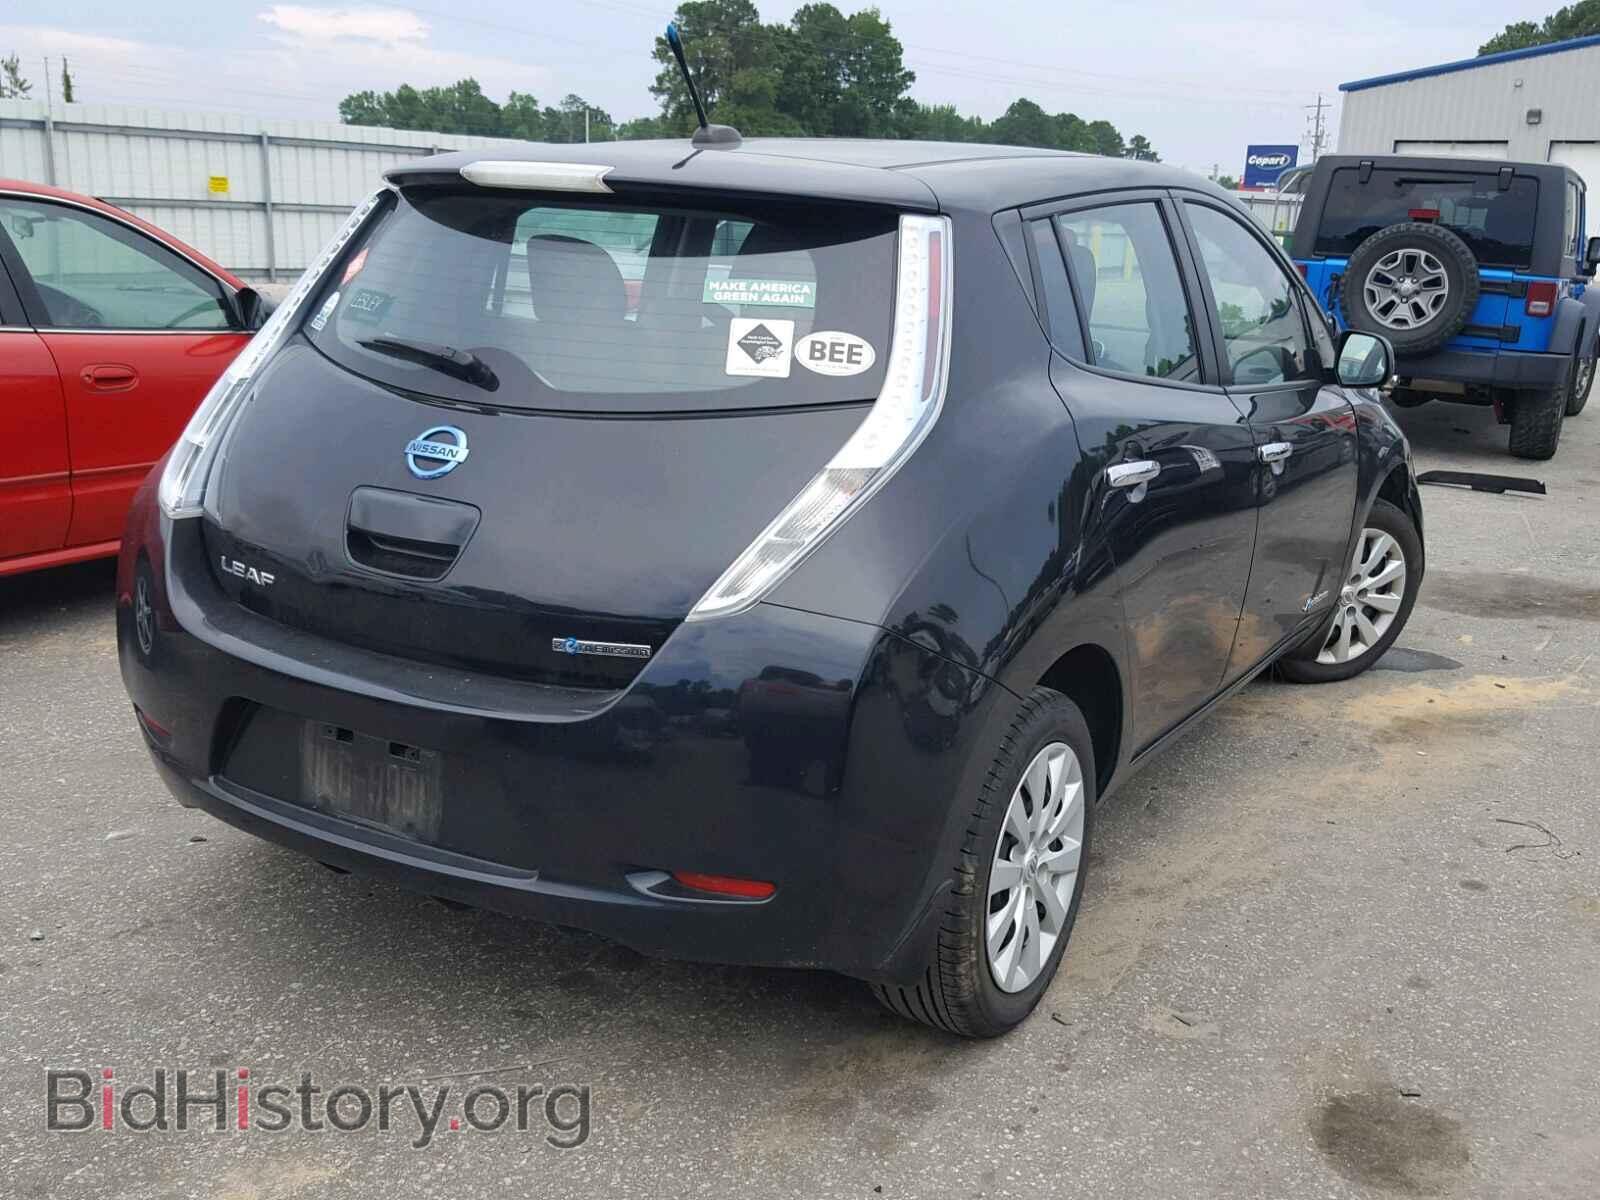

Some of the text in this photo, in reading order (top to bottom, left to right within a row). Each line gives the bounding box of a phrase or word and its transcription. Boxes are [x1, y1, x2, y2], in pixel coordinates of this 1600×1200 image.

[1248, 154, 1286, 166] Copart
[709, 281, 811, 294] MAKE AMERICA
[713, 291, 805, 304] GREEN AGAIN
[809, 340, 863, 365] BEE
[408, 442, 458, 458] NISSAN
[221, 555, 275, 586] LEAF
